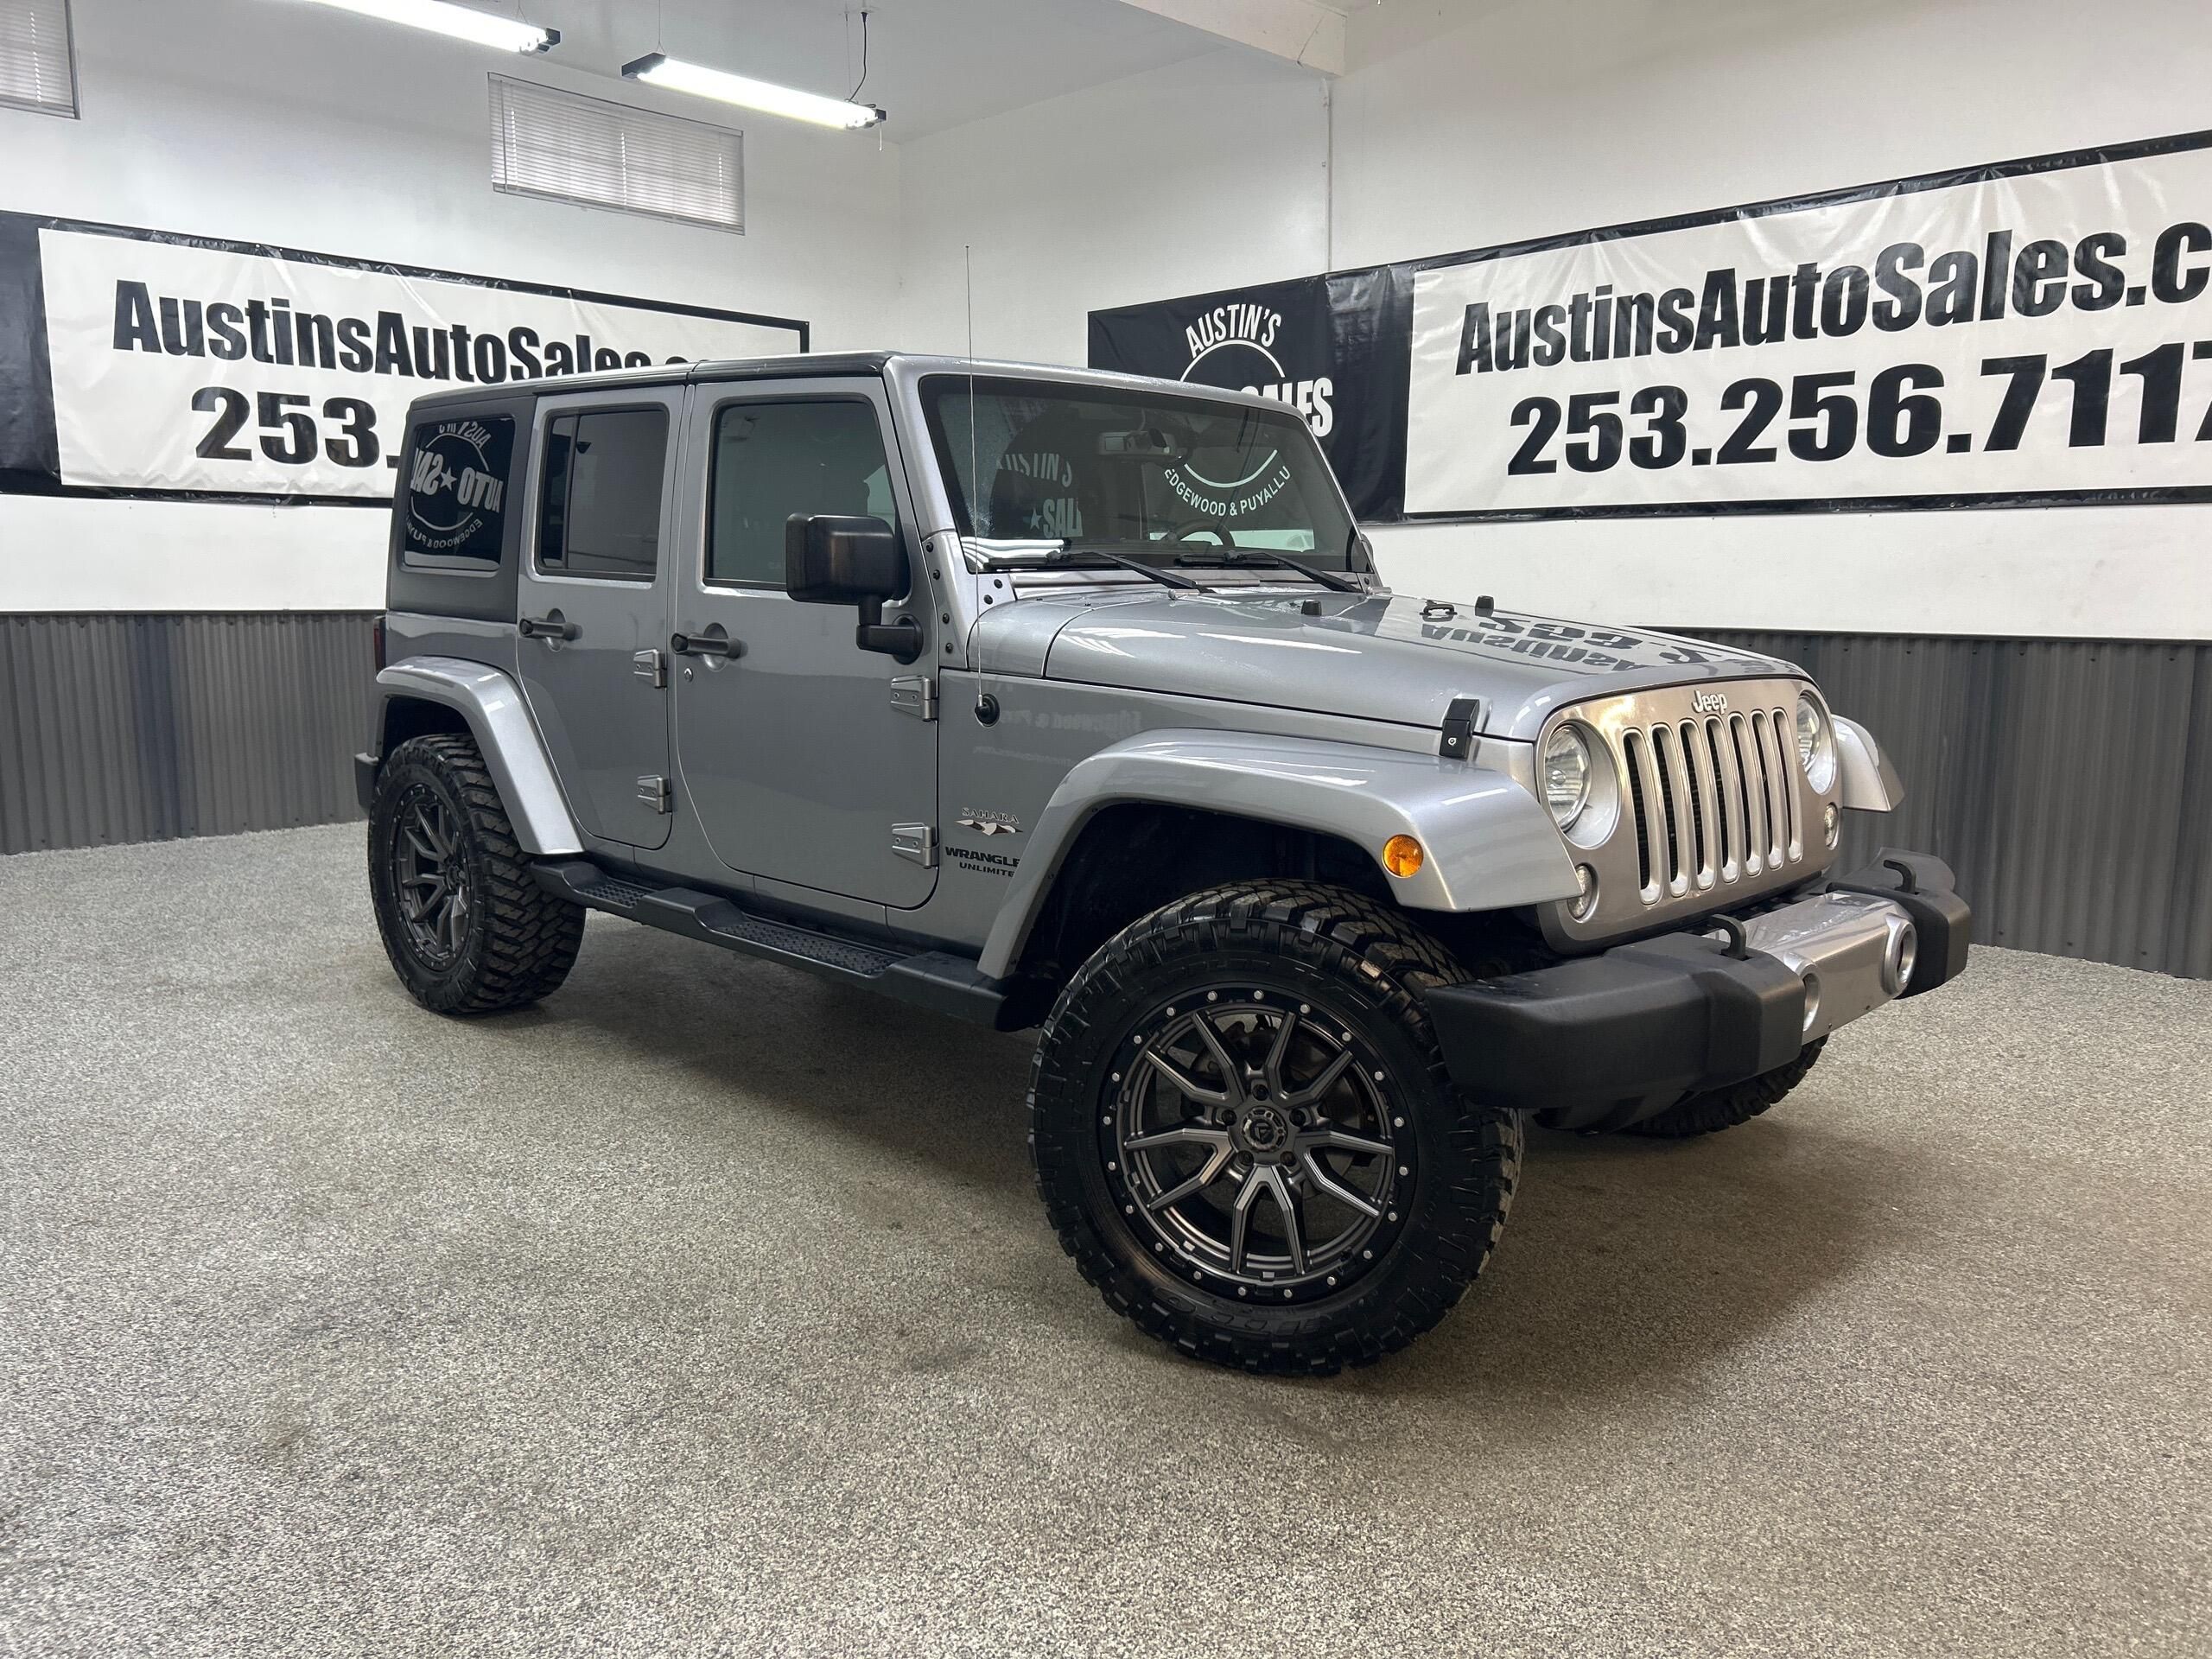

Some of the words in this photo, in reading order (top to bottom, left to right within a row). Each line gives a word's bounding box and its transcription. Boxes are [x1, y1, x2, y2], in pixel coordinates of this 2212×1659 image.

[1185, 304, 1281, 359] AUSTIN'S
[1508, 340, 2212, 476] 253.256.711
[1165, 468, 1227, 518] EDGEWOOD
[1230, 502, 1238, 517] &
[1691, 690, 1728, 715] Jeep
[962, 808, 1020, 823] SAHARA
